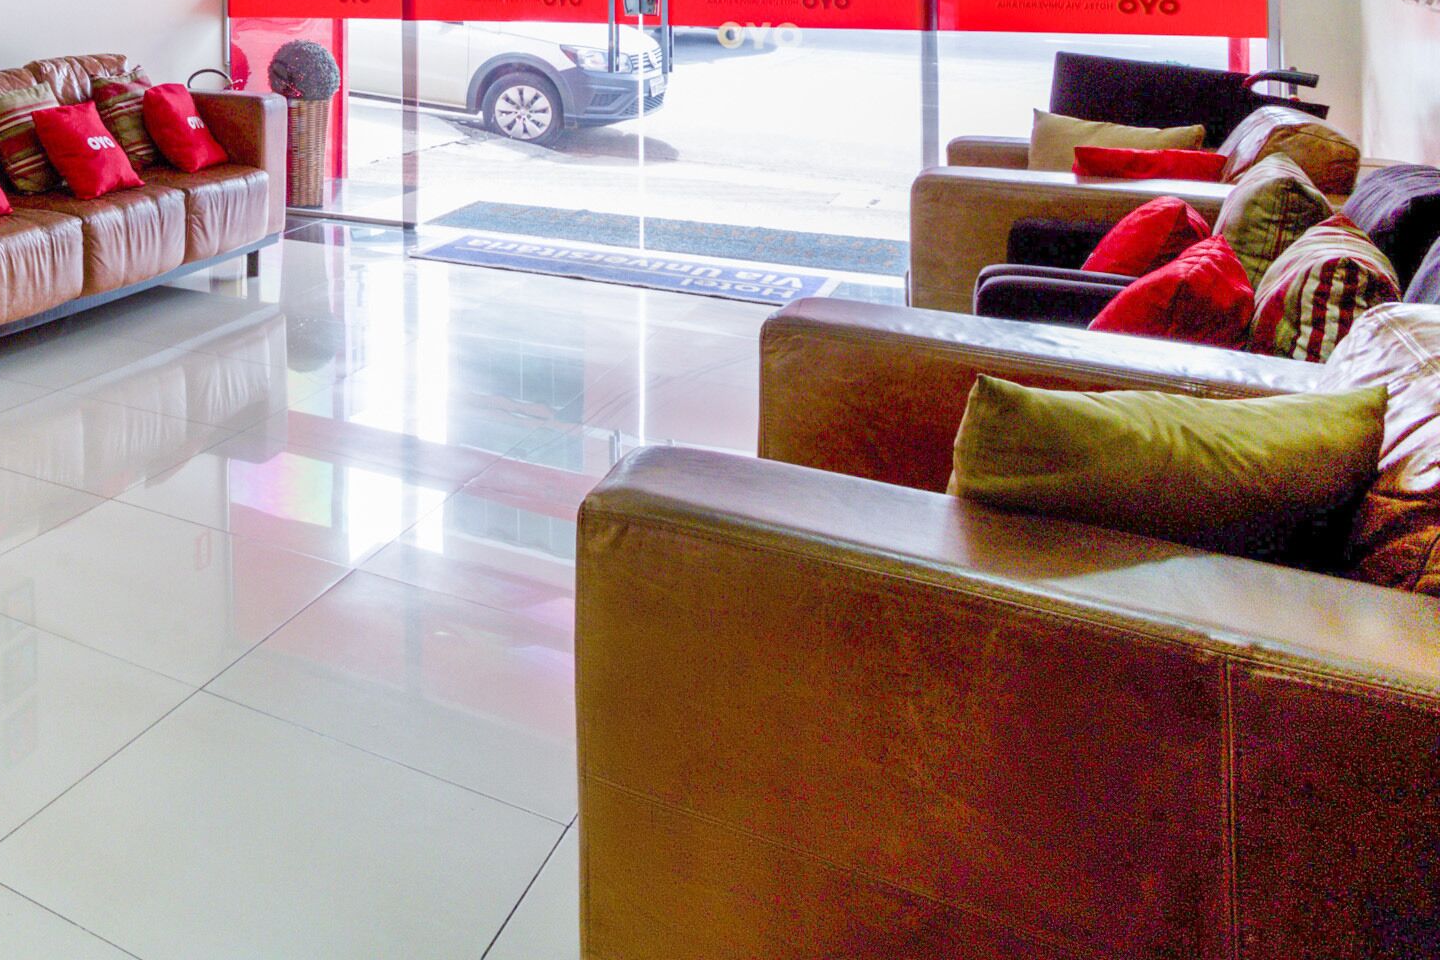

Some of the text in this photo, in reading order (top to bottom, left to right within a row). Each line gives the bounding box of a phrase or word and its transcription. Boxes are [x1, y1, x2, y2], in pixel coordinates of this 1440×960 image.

[87, 135, 115, 151] OYO
[680, 277, 797, 299] Hotel
[735, 271, 803, 289] Via
